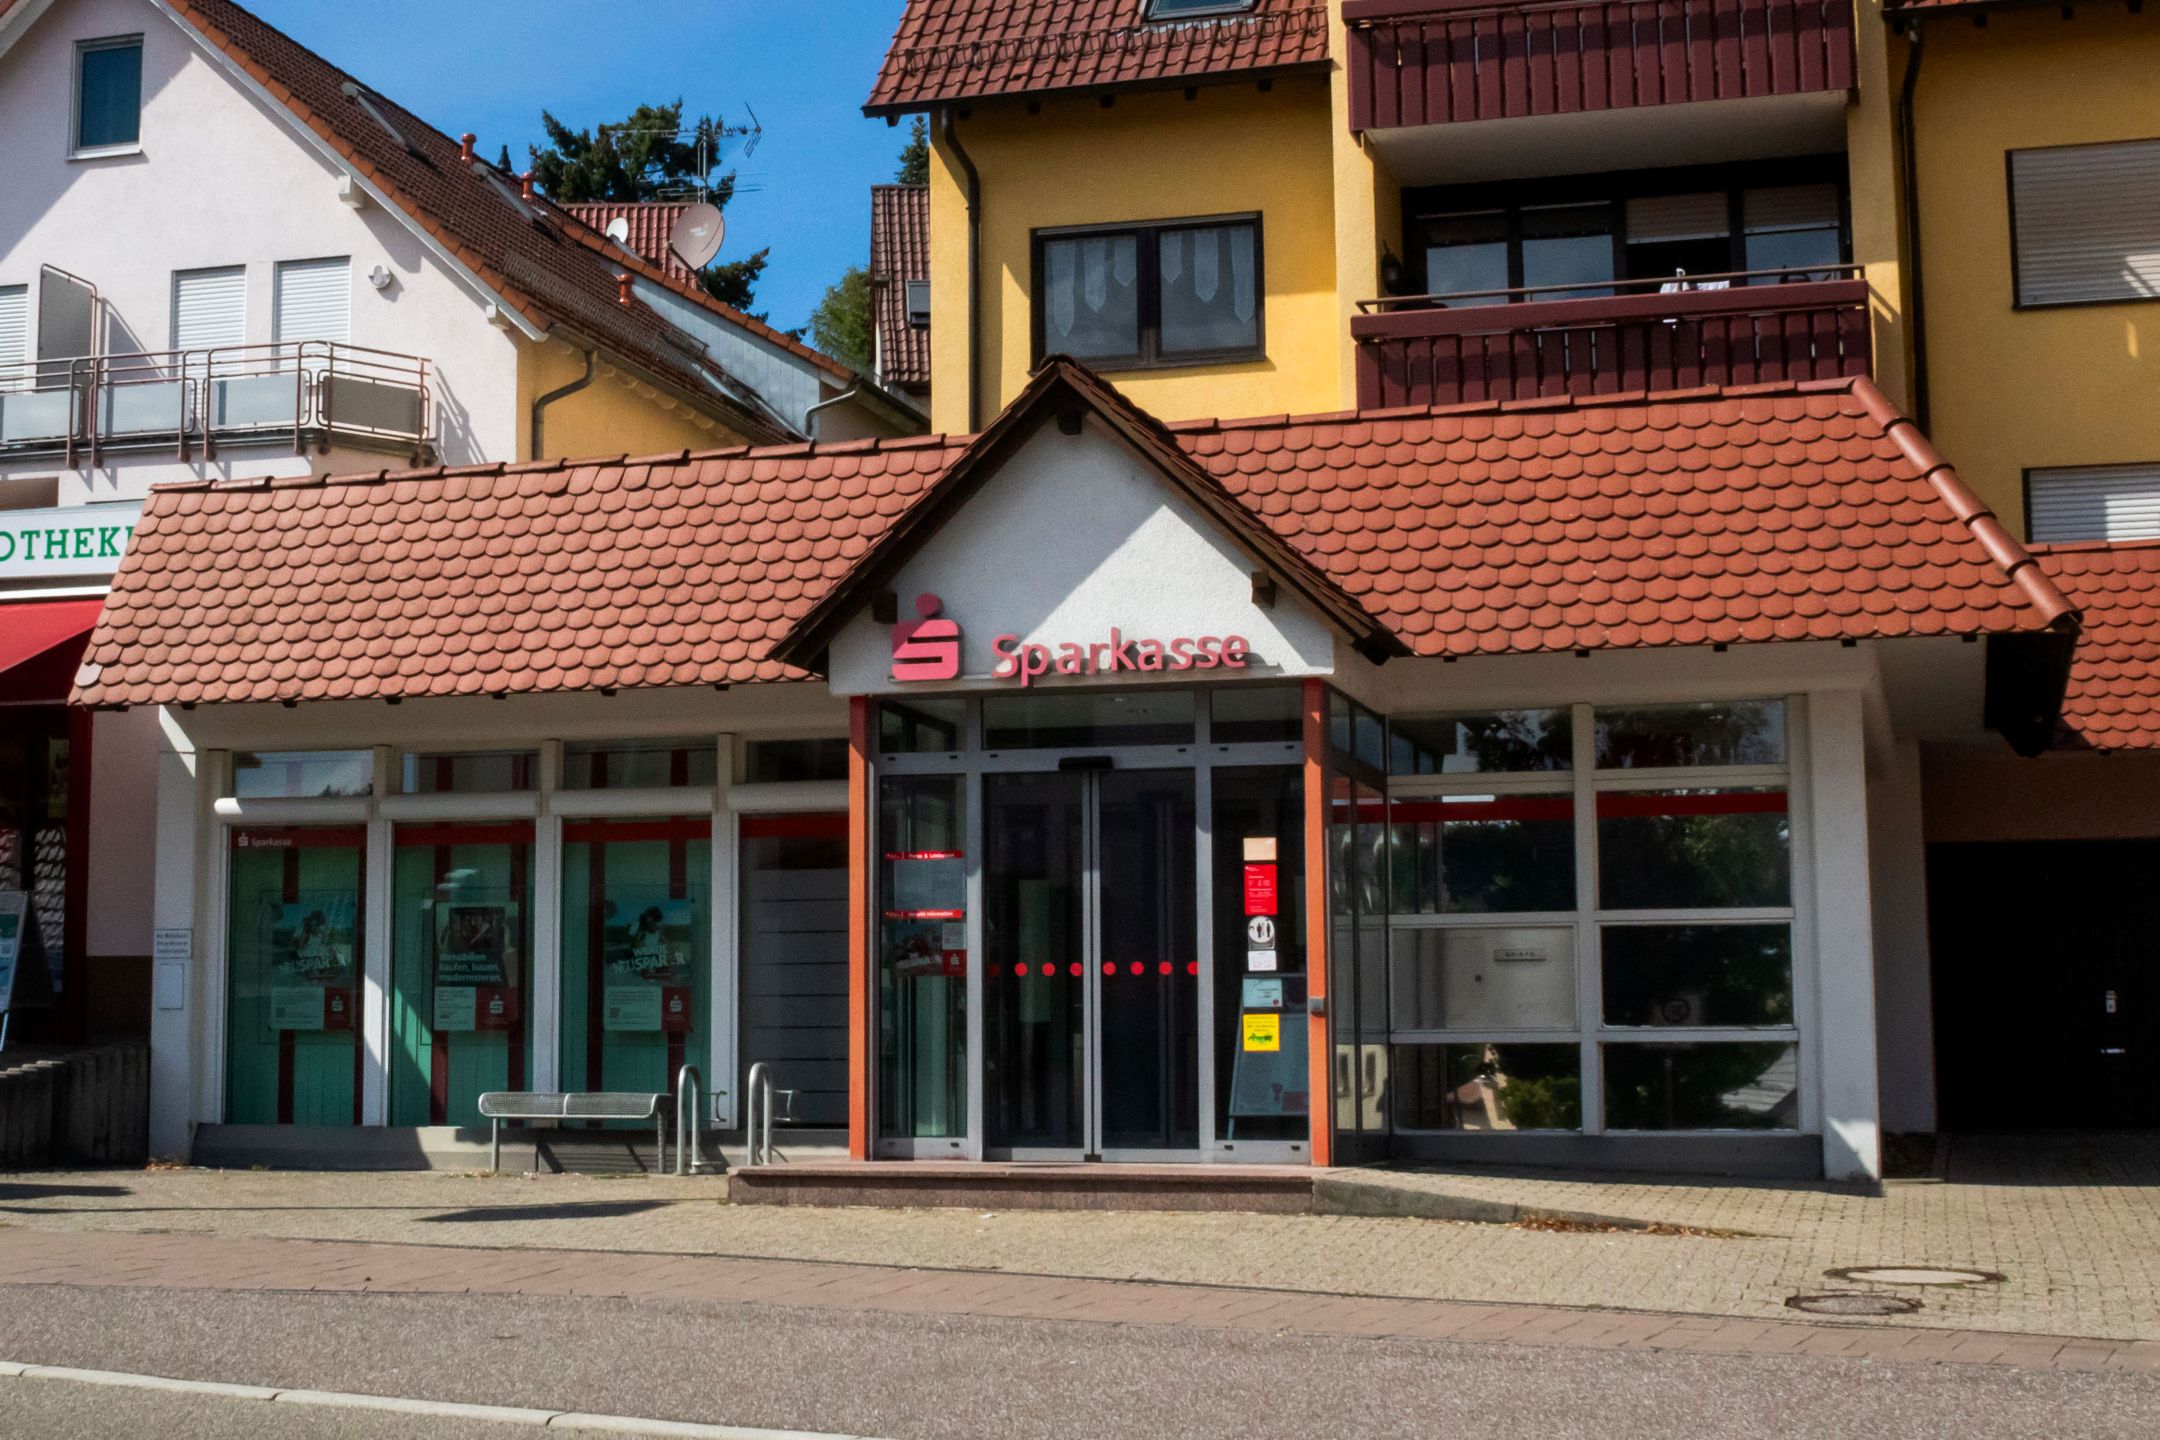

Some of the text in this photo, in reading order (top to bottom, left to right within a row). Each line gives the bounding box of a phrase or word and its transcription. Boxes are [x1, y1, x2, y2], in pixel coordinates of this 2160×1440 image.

[991, 626, 1250, 687] Sparkasse
[250, 836, 292, 848] Sparkasse
[439, 952, 486, 961] Immobilien
